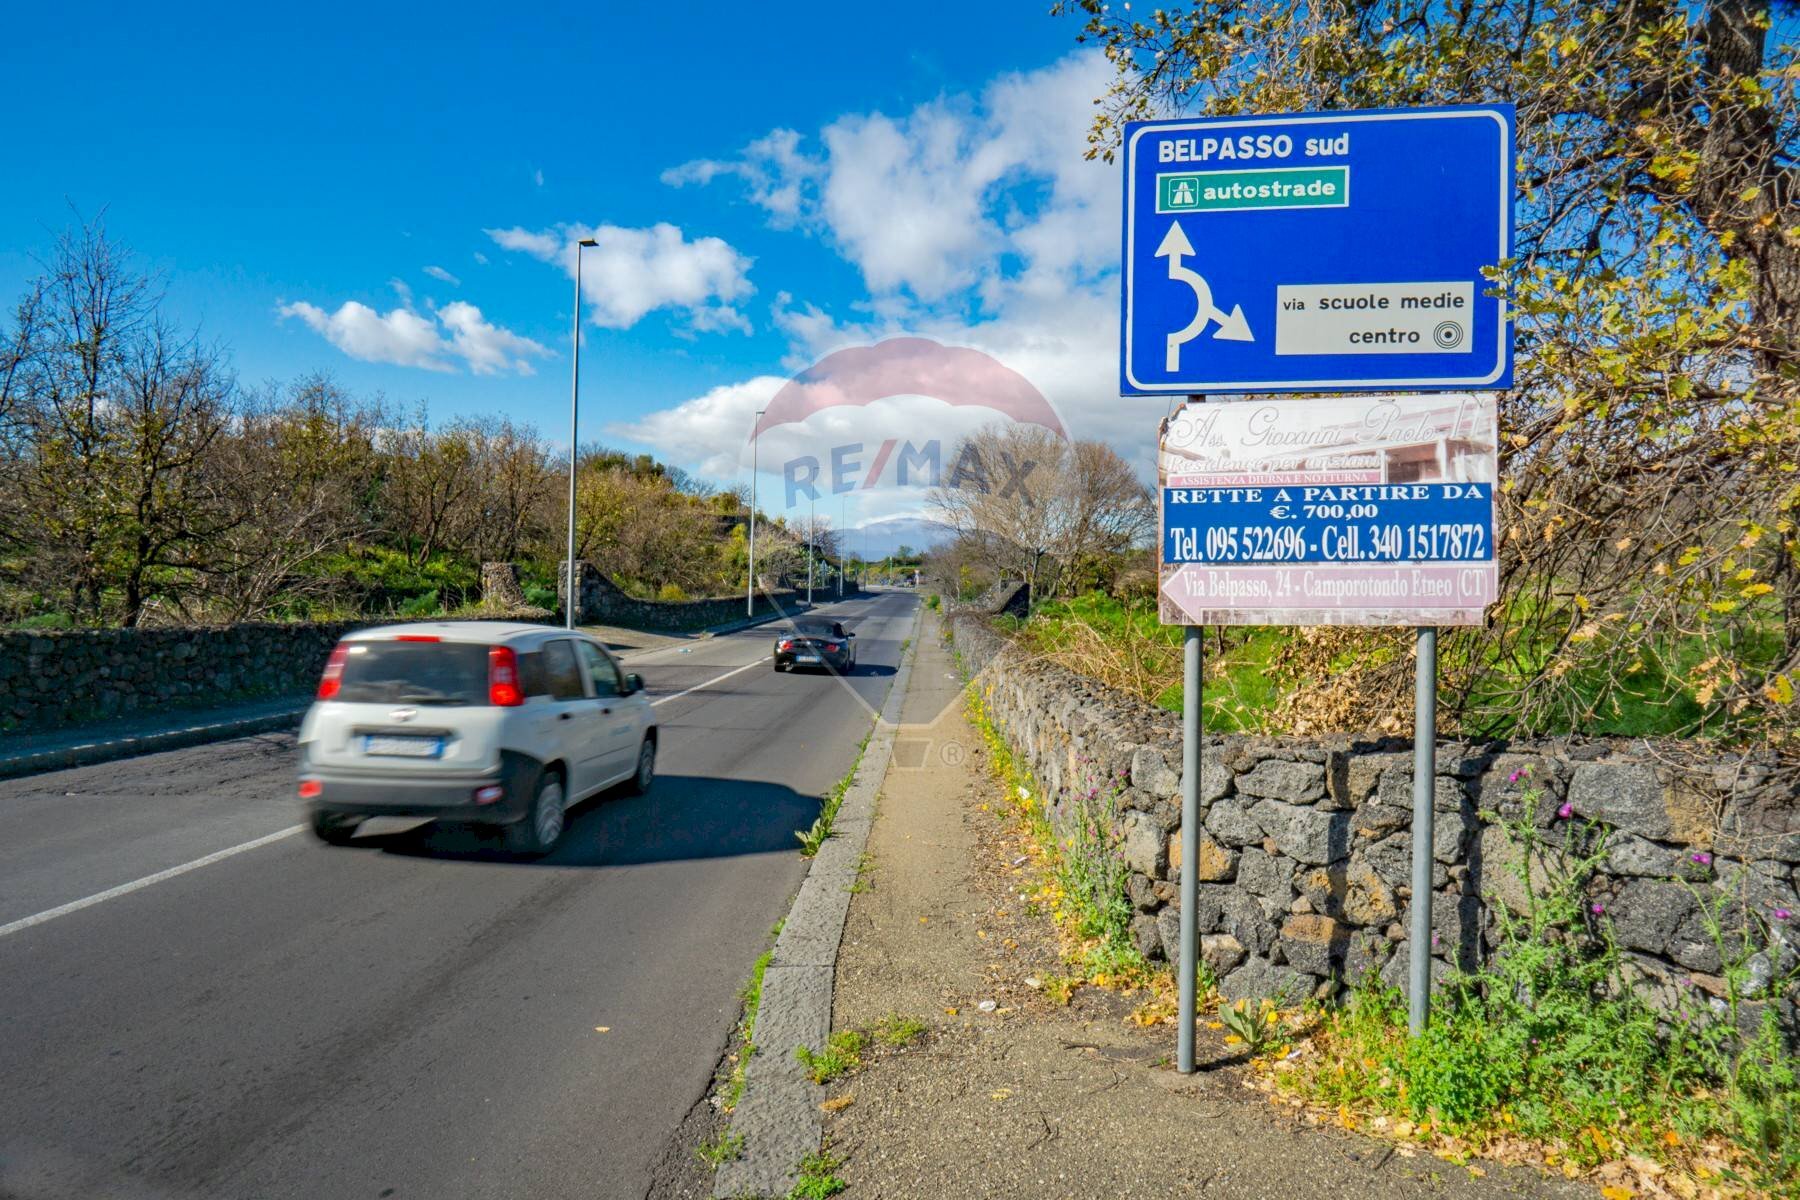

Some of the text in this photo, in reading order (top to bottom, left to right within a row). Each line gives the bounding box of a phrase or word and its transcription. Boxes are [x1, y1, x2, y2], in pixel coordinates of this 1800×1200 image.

[1158, 132, 1349, 163] BELPASSO sud
[1203, 178, 1336, 201] autostrade
[1283, 292, 1465, 312] via scuole medie
[1349, 327, 1421, 344] centro
[1241, 406, 1343, 447] Giovanni
[1355, 402, 1435, 441] Paolo
[1180, 473, 1368, 486] ASSISTENZA DIURNA E NOTTURNA
[1171, 485, 1485, 504] RETTE A PARTIRE DA
[1269, 503, 1379, 521] €. 700,00
[1170, 527, 1204, 560] Tel.
[1206, 526, 1238, 561] 095
[1242, 525, 1306, 561] 522696
[1321, 525, 1366, 560] Cell.
[1368, 524, 1403, 560] 340
[1407, 523, 1485, 560] 1517872
[1183, 571, 1205, 597] Via
[1208, 570, 1272, 605] Belpasso,
[1275, 570, 1292, 597] 24
[1303, 569, 1408, 605] Camporotondo
[1412, 569, 1453, 597] Etneo
[1456, 568, 1488, 606] (CT)
